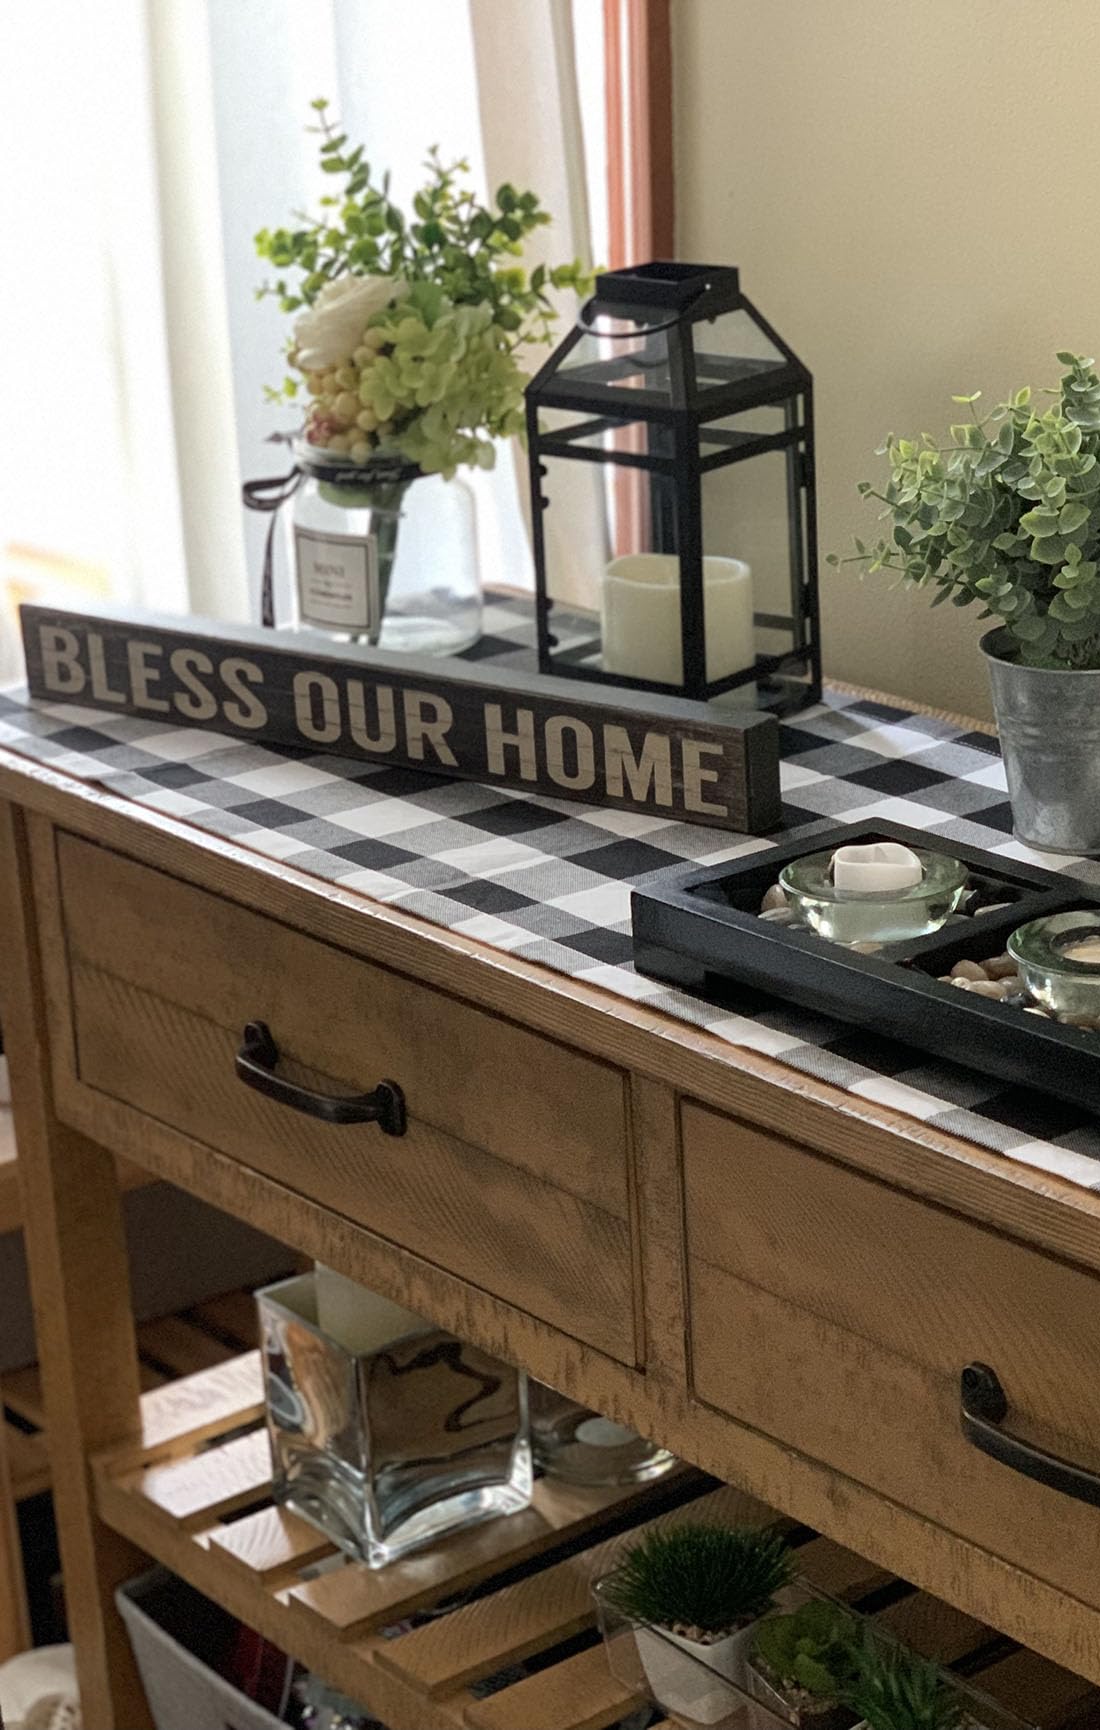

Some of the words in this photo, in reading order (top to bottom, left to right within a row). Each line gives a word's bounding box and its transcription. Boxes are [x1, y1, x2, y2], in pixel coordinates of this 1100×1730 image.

[41, 625, 269, 729] BLESS
[293, 671, 458, 766] OUR
[485, 704, 728, 817] HOME
